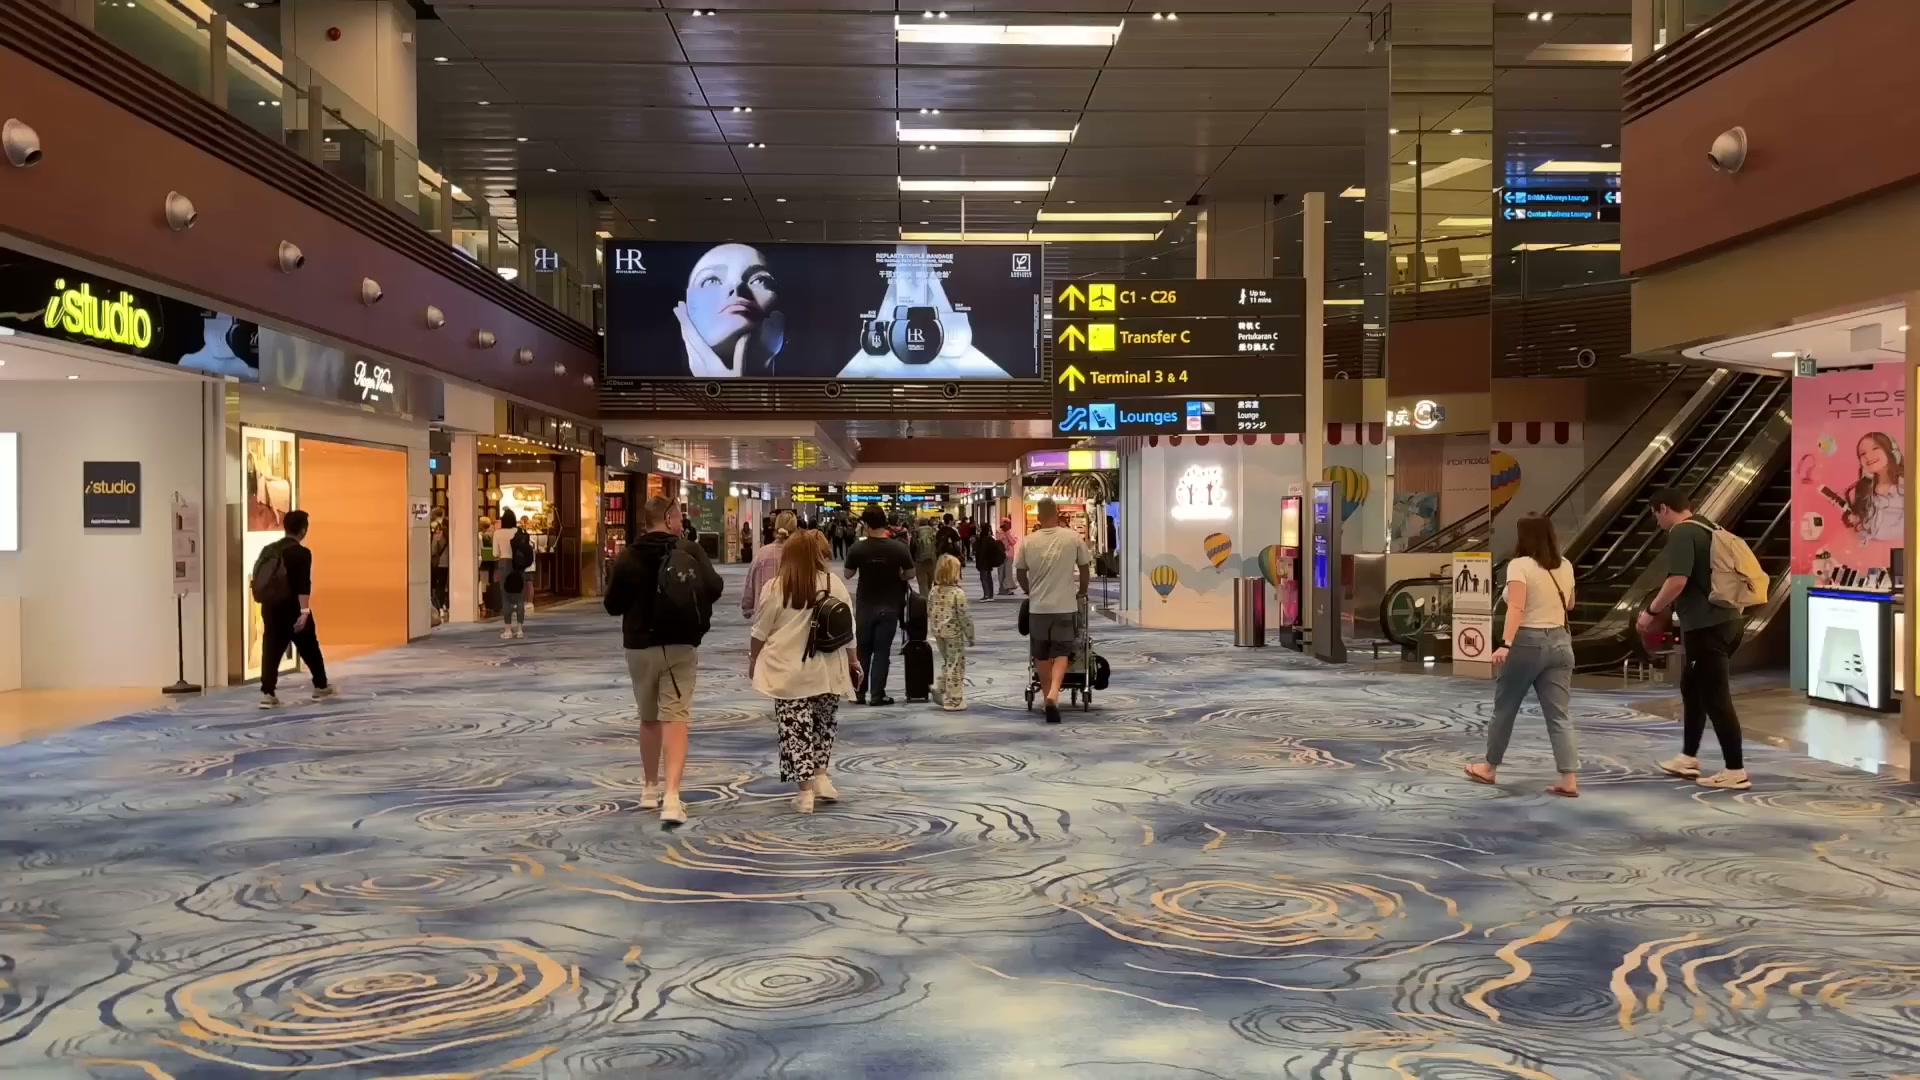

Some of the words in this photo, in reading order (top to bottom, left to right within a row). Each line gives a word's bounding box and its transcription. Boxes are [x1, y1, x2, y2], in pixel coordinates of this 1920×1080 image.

[1568, 194, 1589, 202] Lounge
[1571, 211, 1592, 219] Lounge
[615, 249, 647, 270] HR
[1120, 291, 1136, 303] C1
[1151, 291, 1177, 303] C26
[1249, 290, 1259, 298] Up
[44, 278, 152, 349] istudio
[1120, 330, 1176, 344] Transfer
[1180, 330, 1191, 344] C
[1238, 332, 1272, 340] Pertukaran
[1273, 332, 1278, 340] C
[1801, 361, 1813, 374] EXIT
[1090, 370, 1150, 384] Terminal
[1154, 370, 1163, 383] 3
[1168, 372, 1175, 383] &
[1179, 370, 1188, 383] 4
[1120, 410, 1178, 425] Lounges
[1238, 411, 1259, 420] Lounge
[85, 479, 136, 494] istudio
